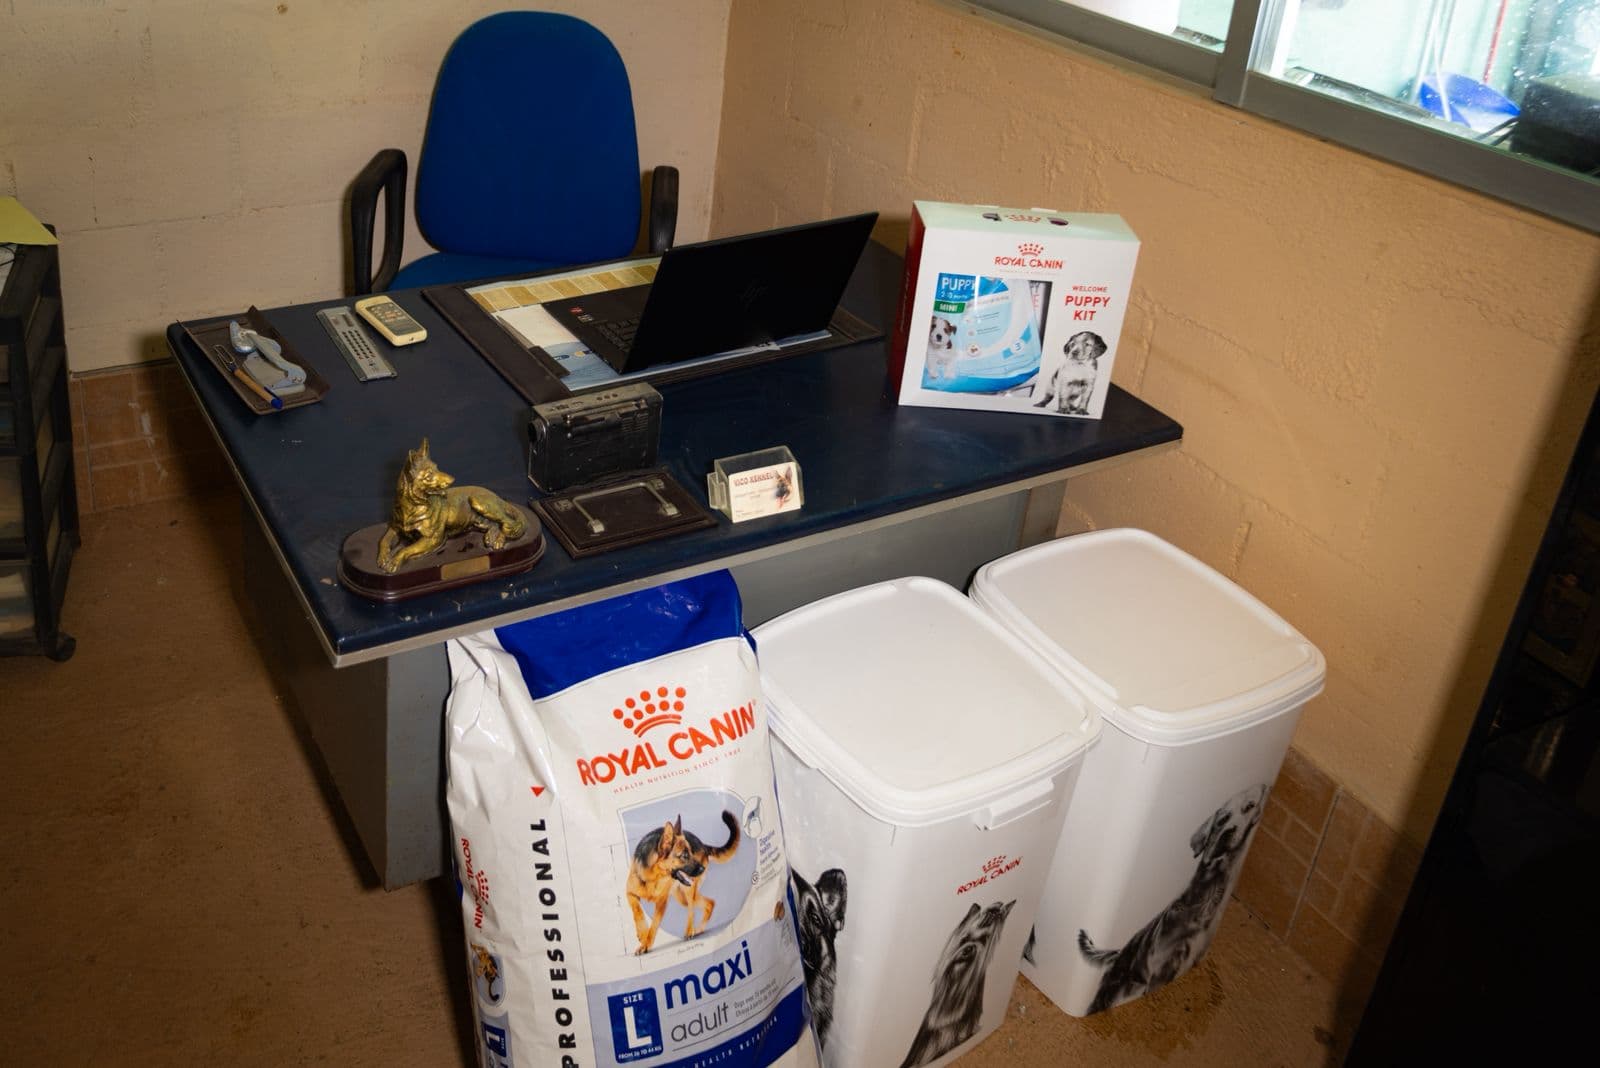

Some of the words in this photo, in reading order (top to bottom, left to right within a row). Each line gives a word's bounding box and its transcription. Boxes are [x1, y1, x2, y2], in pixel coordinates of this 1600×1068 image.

[994, 256, 1027, 268] ROYAL
[1029, 258, 1064, 270] CANIN
[1064, 295, 1111, 308] PUPPY
[1071, 285, 1108, 293] WELCOME
[1073, 310, 1097, 321] KIT
[576, 742, 668, 786] ROYAL
[667, 701, 756, 760] CANIN
[613, 780, 644, 794] HEALTH
[647, 767, 691, 784] NUTRITION
[461, 837, 475, 882] ROYAL
[957, 875, 988, 895] ROYAL
[530, 818, 579, 1068] PROFESSIONAL
[664, 940, 753, 1010] maxi
[623, 992, 644, 1005] SIZE
[623, 1006, 652, 1049] L
[671, 1002, 730, 1042] adult
